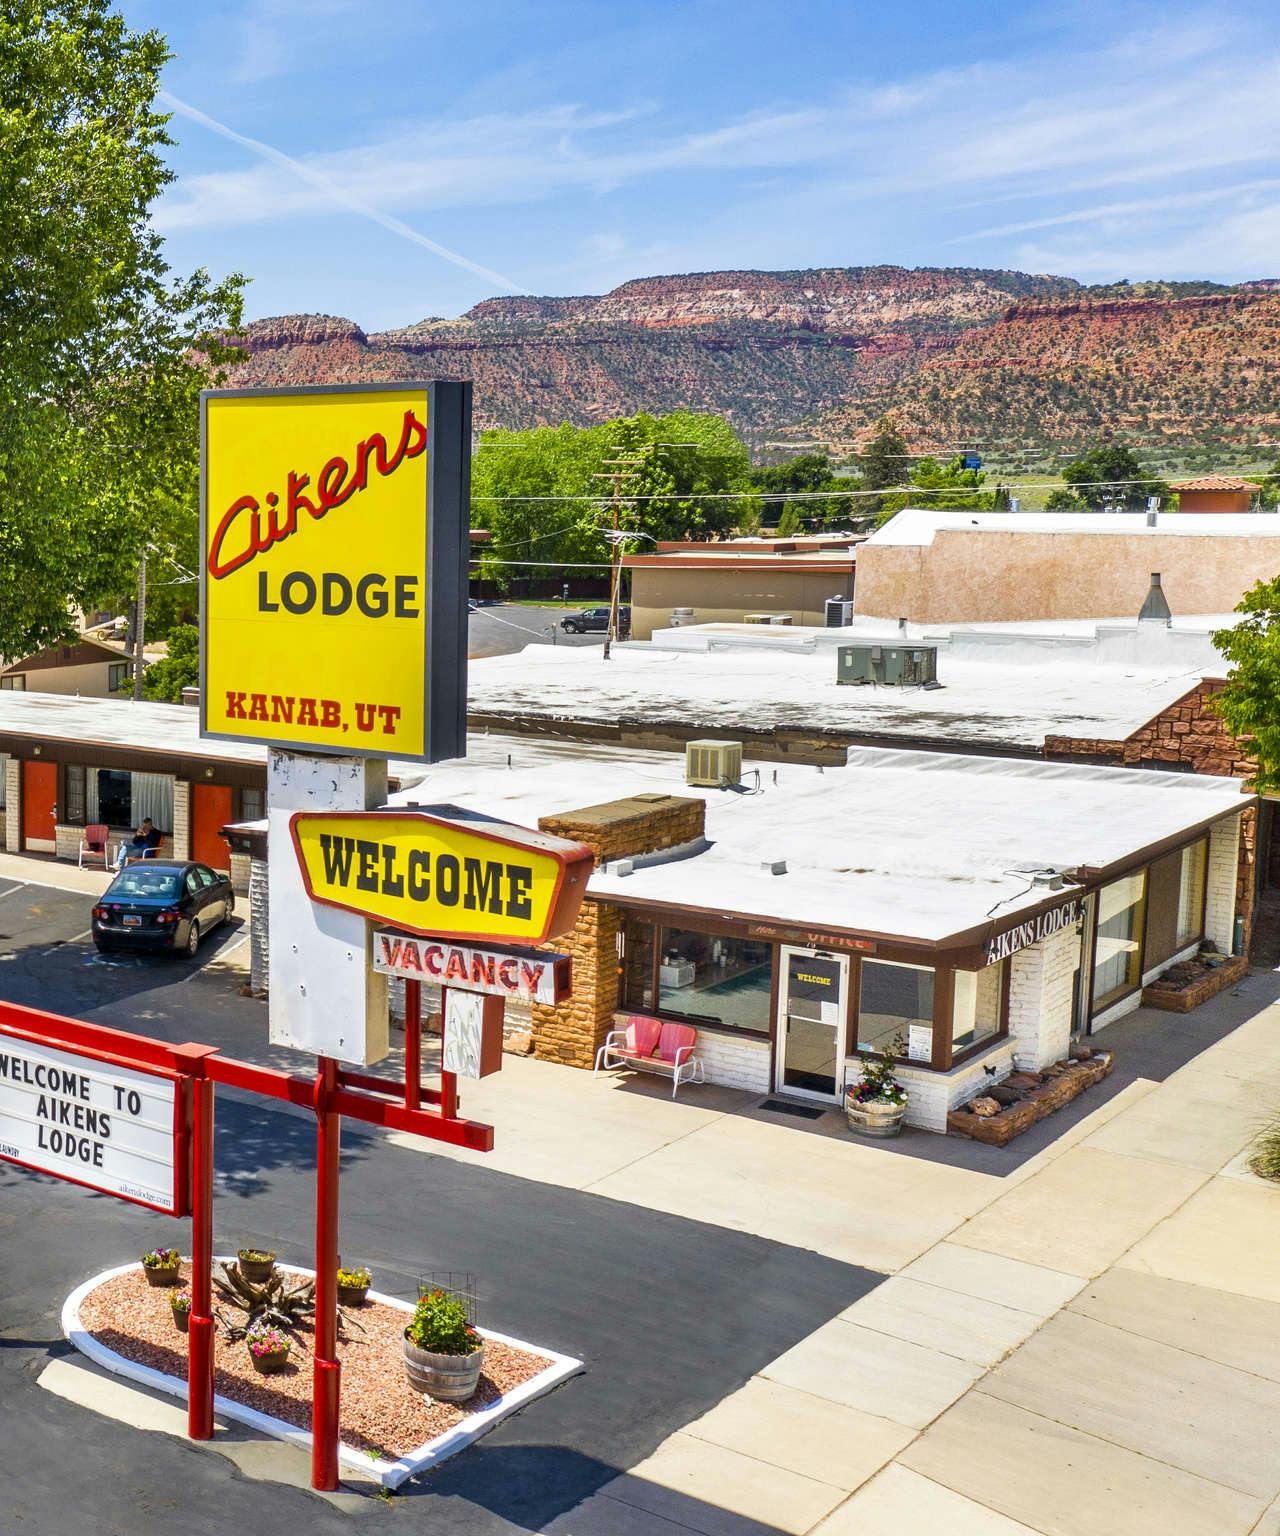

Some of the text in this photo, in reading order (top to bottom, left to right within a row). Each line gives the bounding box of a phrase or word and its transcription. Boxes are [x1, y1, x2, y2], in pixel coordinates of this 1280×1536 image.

[208, 409, 427, 579] Aikens
[258, 571, 419, 619] LODGE
[226, 691, 401, 734] KANAB, UT
[320, 834, 533, 920] WELCOME
[986, 901, 1076, 966] AIKENS LODGE
[381, 936, 545, 993] VACANCY
[797, 973, 831, 985] WELCOME
[37, 1094, 111, 1138] AIKENS
[114, 1086, 141, 1116] TO
[38, 1125, 104, 1167] LODGE
